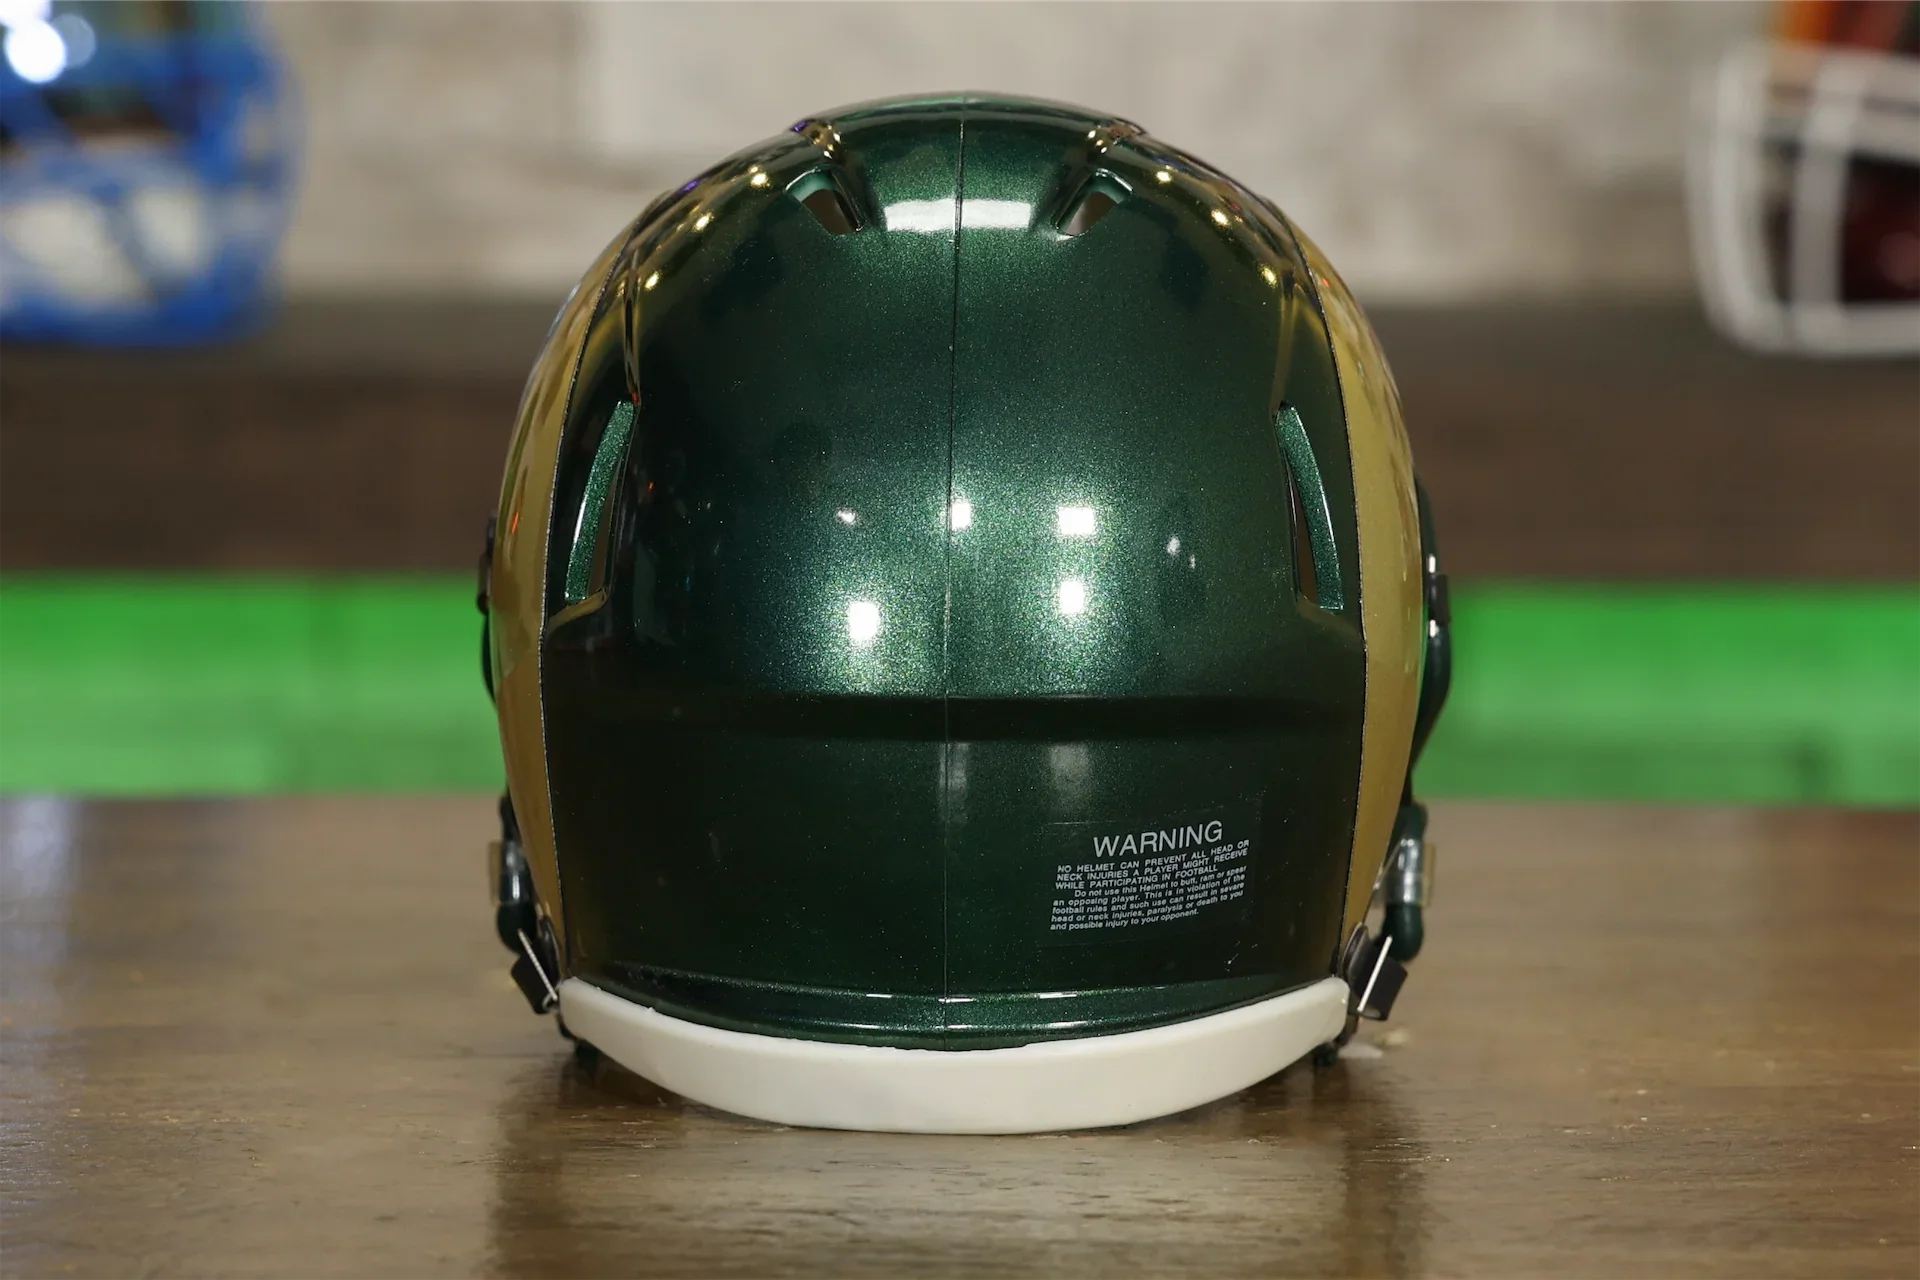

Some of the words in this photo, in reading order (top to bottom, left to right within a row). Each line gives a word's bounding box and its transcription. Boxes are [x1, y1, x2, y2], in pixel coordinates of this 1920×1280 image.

[1093, 820, 1222, 858] WARNING
[1056, 873, 1083, 881] NECK
[1087, 870, 1128, 880] INJURIES
[1144, 864, 1178, 875] PLAYER
[1183, 857, 1210, 870] MIGHT
[1214, 848, 1248, 862] RECEIVE
[1077, 863, 1114, 872] HELMET
[1120, 861, 1140, 869] CAN
[1144, 854, 1186, 866] PREVENT
[1191, 850, 1206, 860] ALL
[1210, 844, 1233, 856] HEAD
[1237, 840, 1249, 849] OR
[1056, 882, 1085, 890] WHILE
[1090, 875, 1158, 888] PARTICIPATING
[1175, 864, 1218, 879] FOOTBALL
[1068, 898, 1108, 906] opposing
[1111, 894, 1140, 904] player.
[1144, 891, 1162, 899] This
[1187, 880, 1220, 892] violation
[1222, 876, 1231, 884] of
[1234, 874, 1245, 882] the
[1140, 882, 1168, 892] Helmet
[1200, 874, 1215, 882] ram
[1226, 866, 1247, 876] spear
[1052, 906, 1084, 914] football
[1111, 902, 1127, 911] and
[1130, 900, 1150, 909] such
[1186, 890, 1208, 900] result
[1088, 912, 1109, 920] neck
[1146, 904, 1183, 916] paralysis
[1196, 896, 1218, 906] death
[1230, 890, 1244, 900] you
[1068, 920, 1104, 930] possible
[1106, 920, 1128, 928] injury
[1141, 915, 1159, 925] your
[1160, 908, 1199, 921] opponent.
